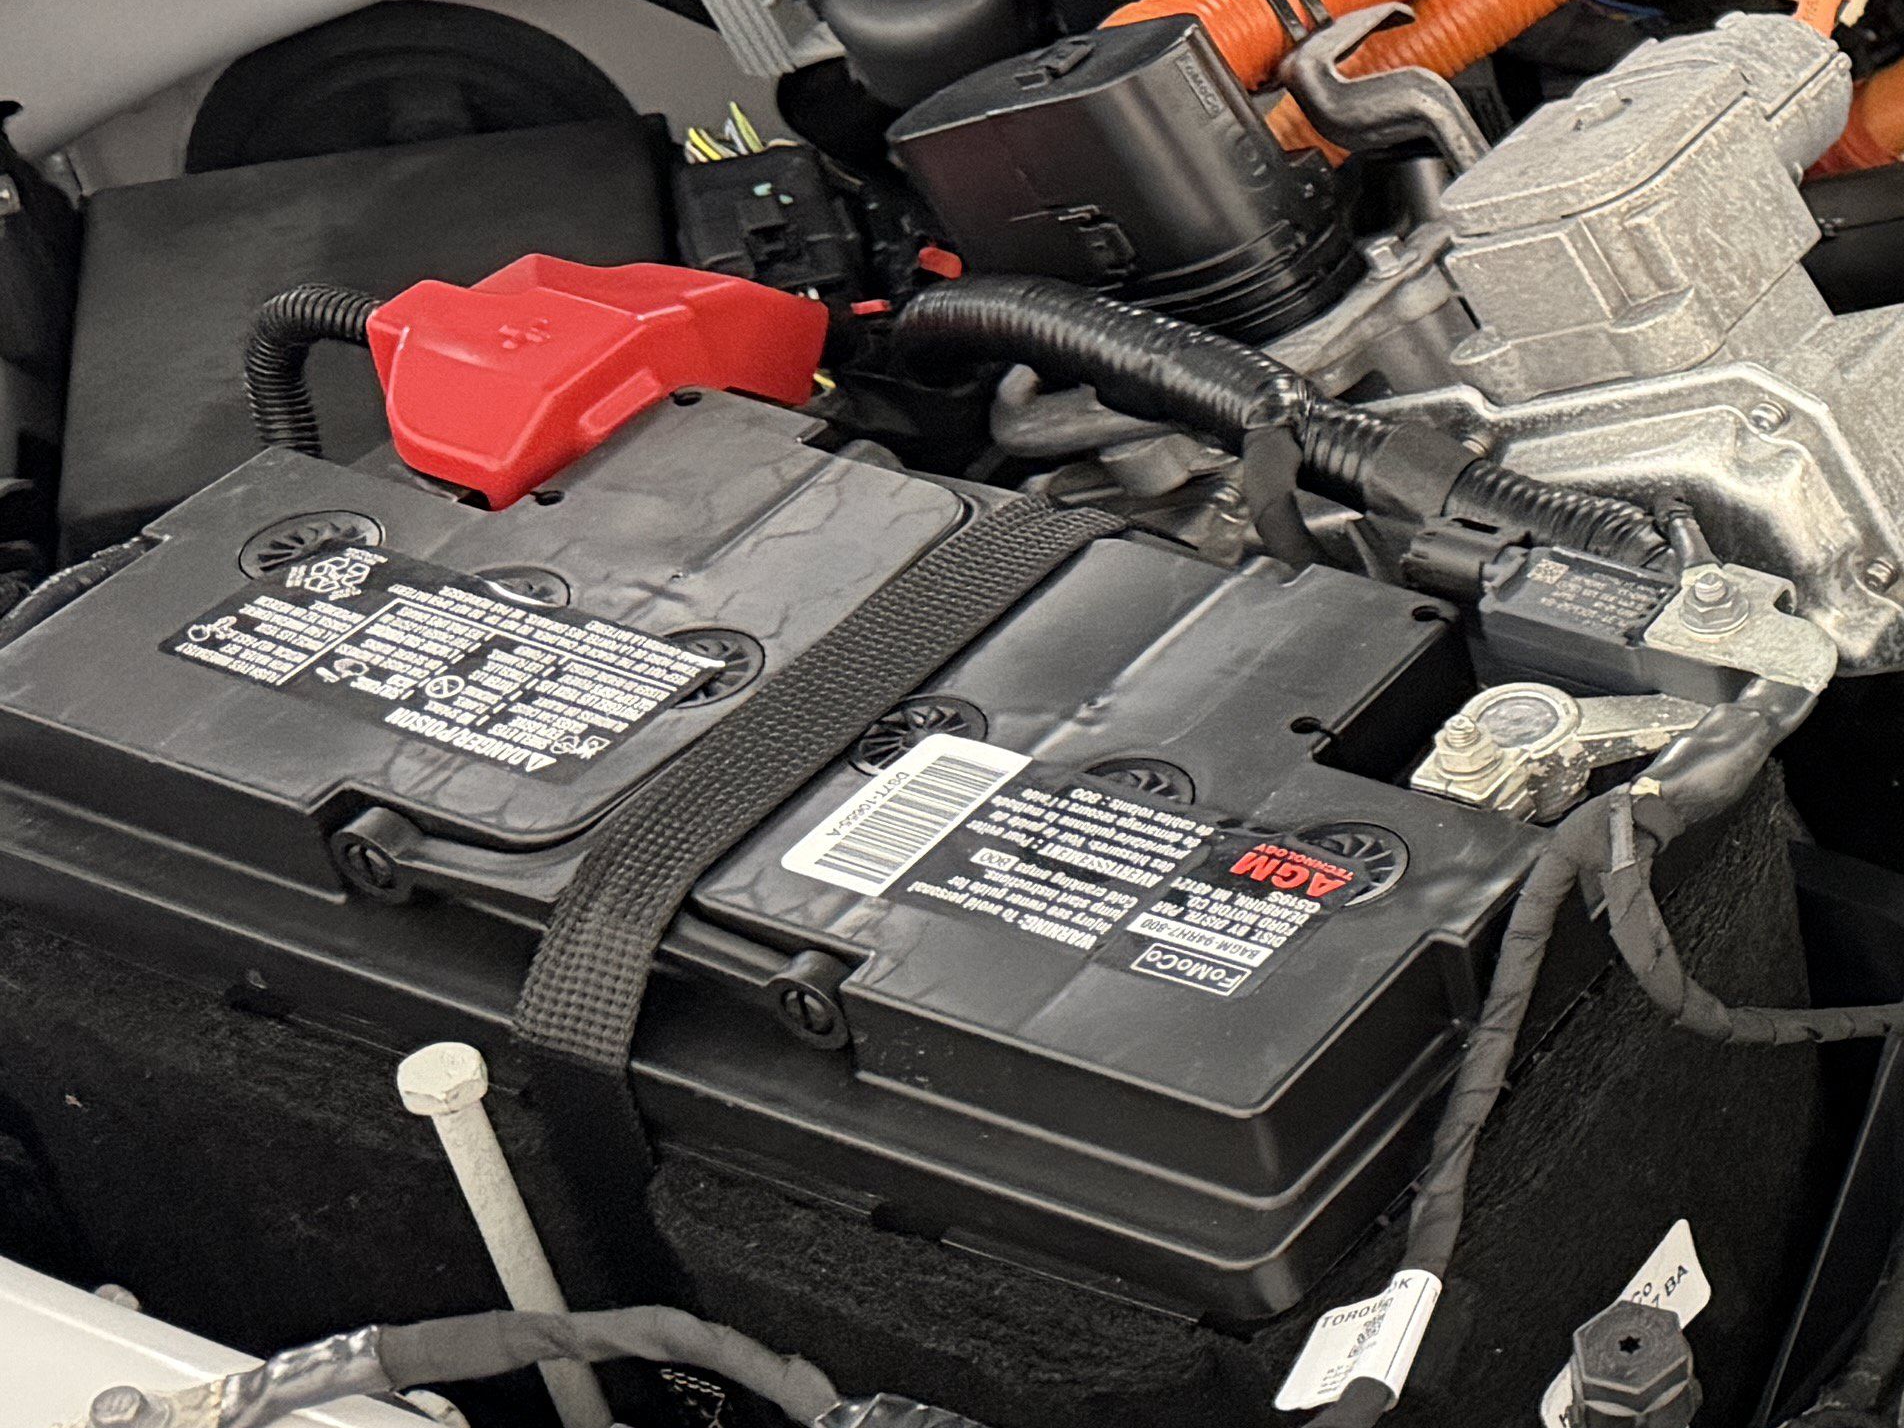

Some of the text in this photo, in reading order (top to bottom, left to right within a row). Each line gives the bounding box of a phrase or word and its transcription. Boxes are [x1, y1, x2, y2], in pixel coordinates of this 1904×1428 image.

[386, 708, 529, 763] DANGER/POISON
[1070, 788, 1101, 803] 800
[1038, 843, 1161, 886] AVERTISSEMENT
[1254, 843, 1352, 879] TECHNOLOGY
[947, 875, 970, 889] for
[979, 852, 1137, 909] Cold cranking amps 800
[1231, 852, 1343, 898] AGM
[968, 881, 1008, 898] guide
[1056, 892, 1090, 908] start
[1210, 887, 1232, 901] MI
[1005, 893, 1046, 911] owner
[1046, 905, 1072, 919] see
[1208, 900, 1259, 924] MOTOR
[907, 881, 1095, 948] WARNING: To avoid personal
[1226, 923, 1250, 936] BY
[1257, 917, 1297, 935] FORD
[1144, 949, 1241, 990] FoMoCo
[1659, 1263, 1690, 1297] BA
